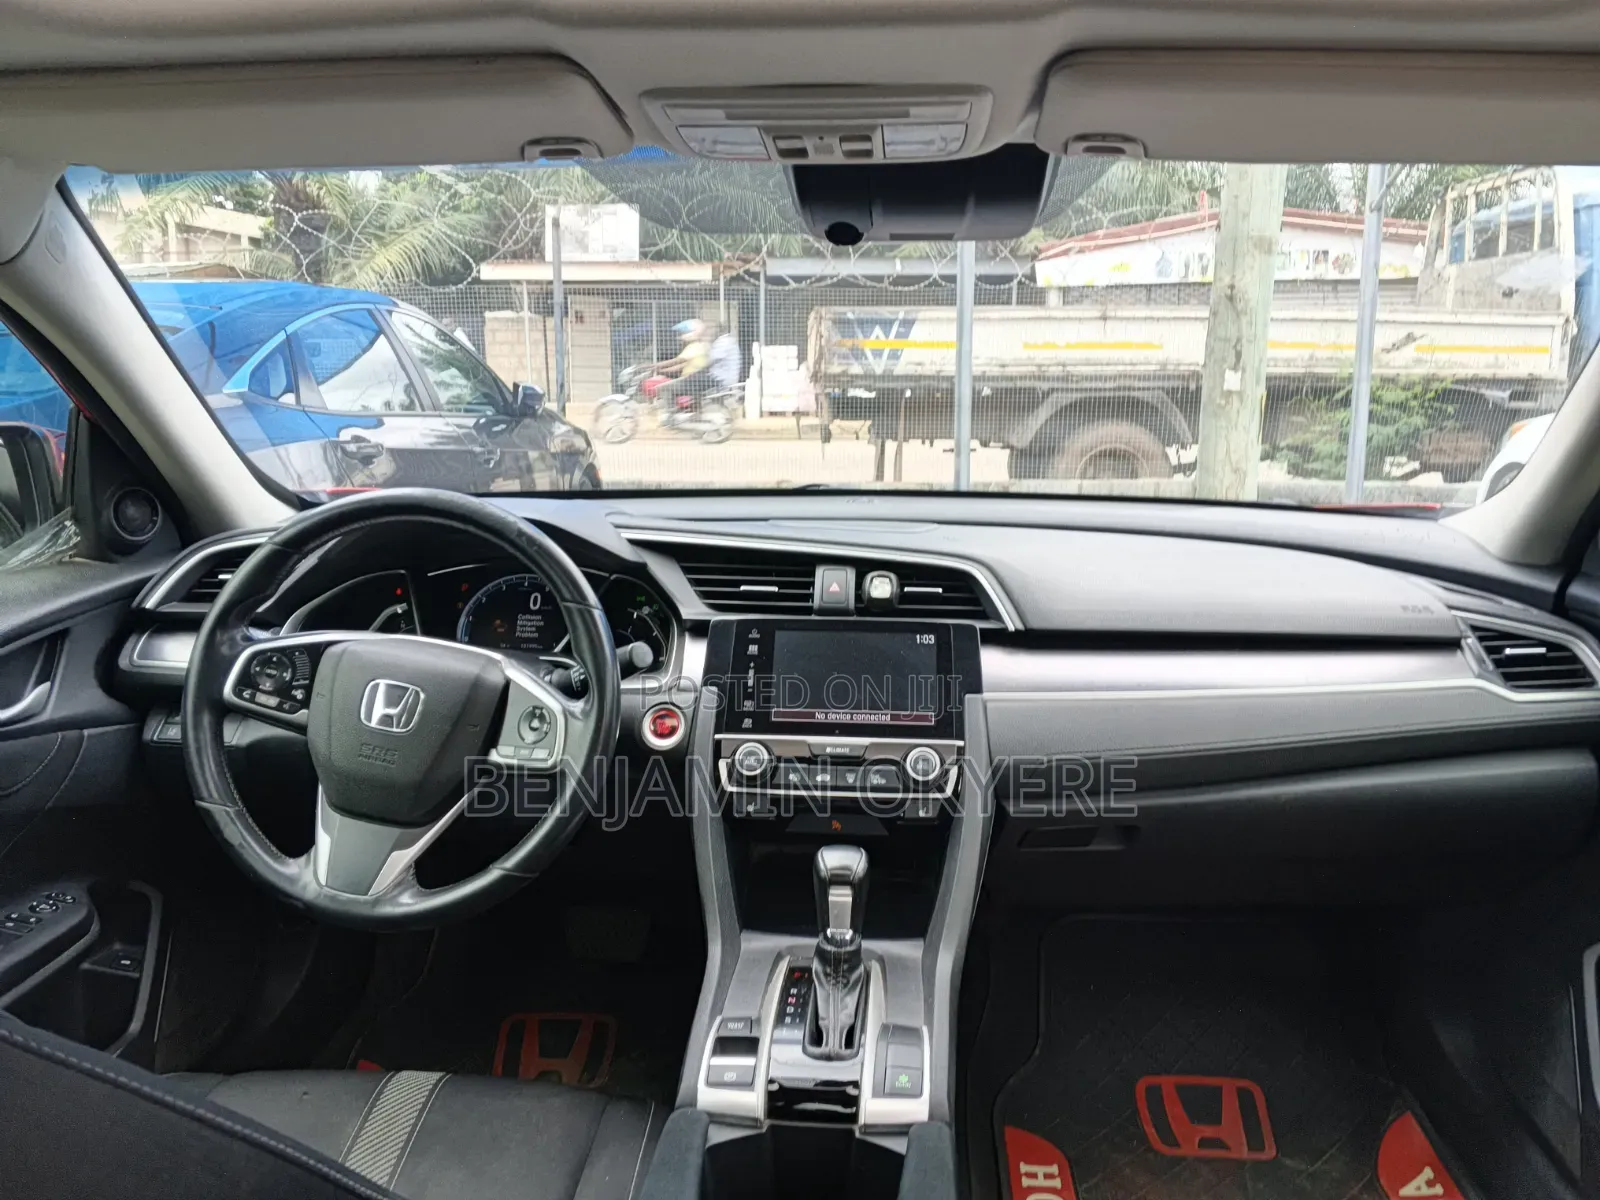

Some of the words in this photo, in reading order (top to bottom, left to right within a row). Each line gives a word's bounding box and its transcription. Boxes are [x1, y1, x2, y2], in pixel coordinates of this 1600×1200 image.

[530, 592, 541, 610] 0
[517, 613, 542, 621] Collision
[916, 633, 935, 645] 1:03
[815, 711, 826, 720] No
[827, 711, 851, 721] device
[852, 712, 891, 721] connected
